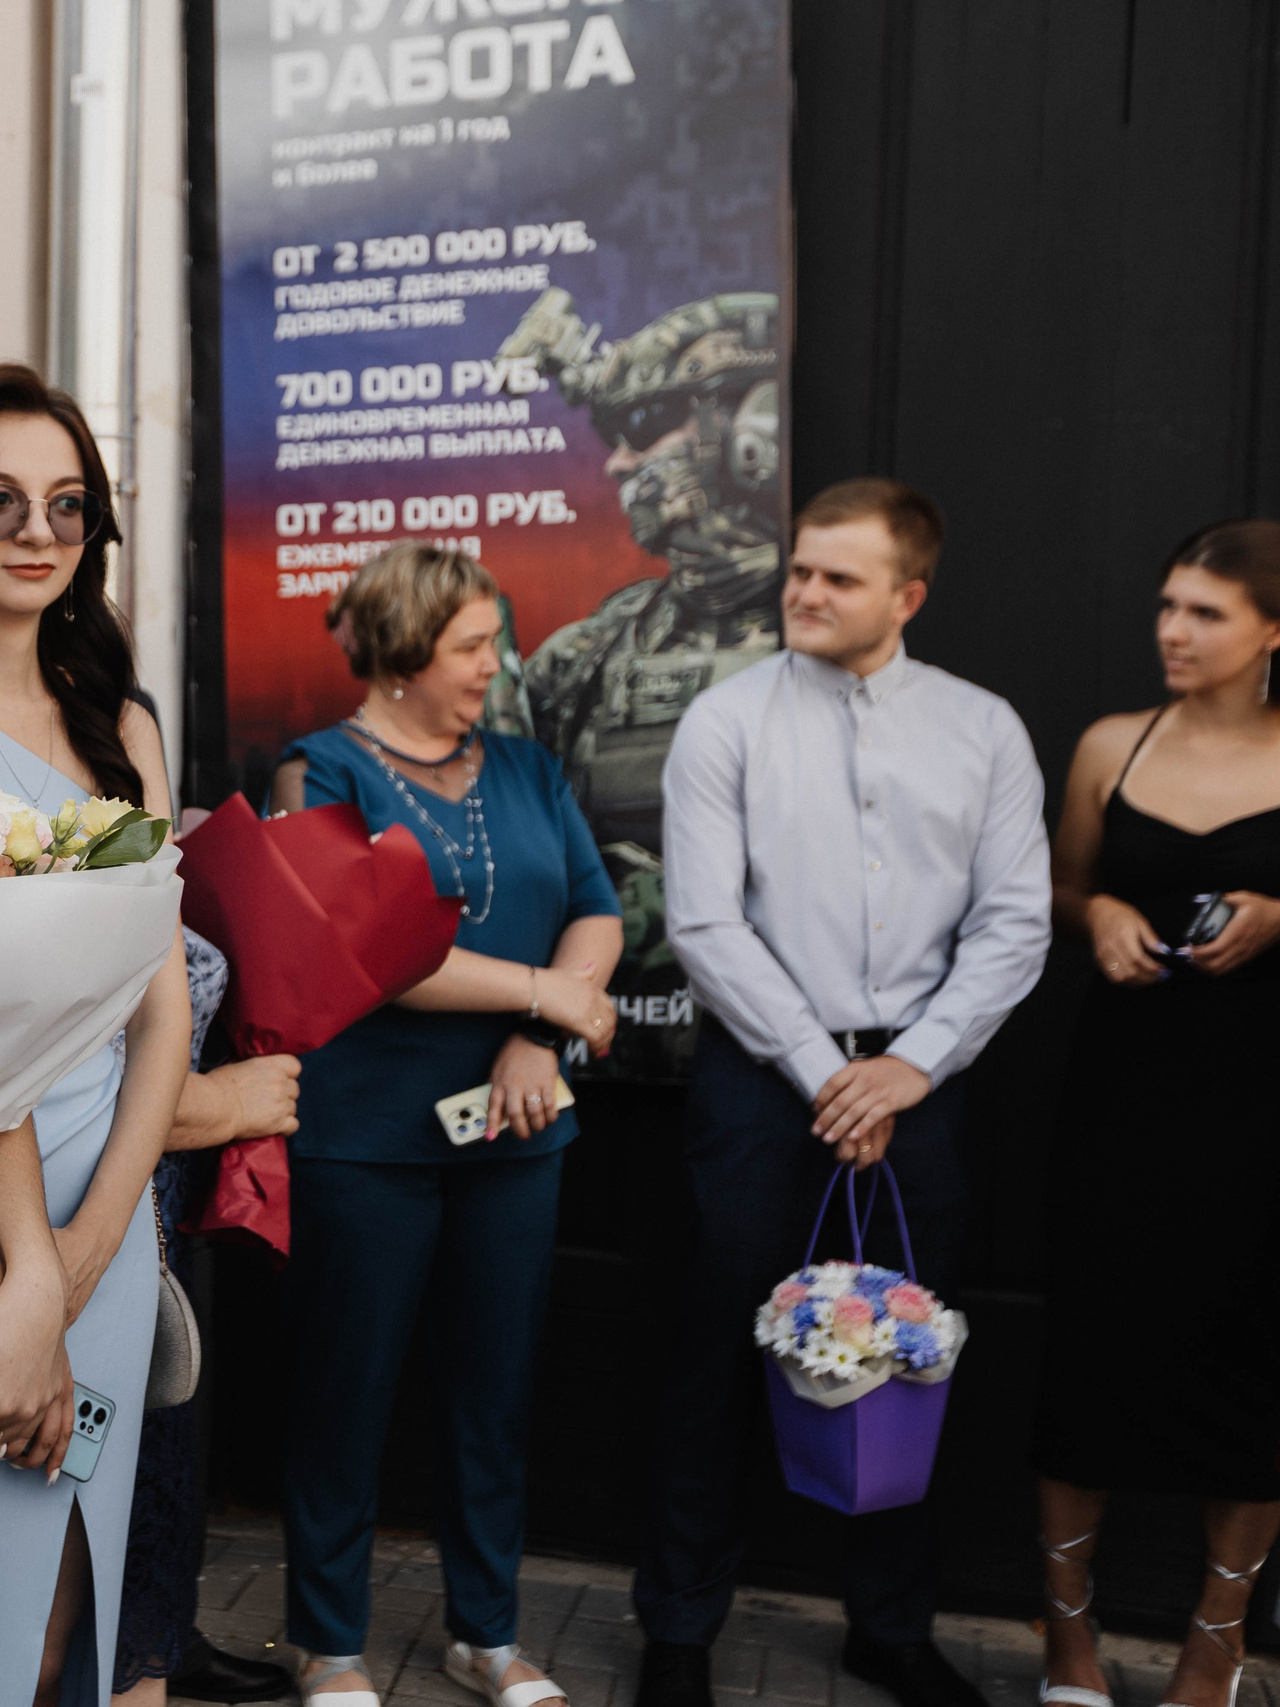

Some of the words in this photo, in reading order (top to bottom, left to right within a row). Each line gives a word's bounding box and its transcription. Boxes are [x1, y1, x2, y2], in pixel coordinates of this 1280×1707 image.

[272, 13, 636, 119] РАБОТА
[439, 116, 454, 144] 1
[456, 115, 511, 143] год
[273, 244, 320, 278] ОТ
[333, 241, 359, 273] 2
[362, 234, 430, 271] 500
[434, 227, 507, 264] 000
[274, 276, 396, 311] ГОДОВОЕ
[398, 263, 550, 301] ДЕНЕЖНОЕ
[273, 299, 466, 342] ДОВОЛЬСТВИЕ
[275, 369, 353, 410] 700
[360, 362, 443, 404] 000
[451, 356, 549, 397] РУБ.
[275, 399, 530, 440] ЕДИНОВРЕМЕННАЯ
[275, 434, 425, 471] ДЕНЕЖНАЯ
[428, 426, 566, 459] ВЫПЛАТА
[275, 502, 328, 537] ОТ
[331, 498, 395, 535] 210
[402, 494, 478, 531] 000
[486, 489, 577, 527] РУБ.
